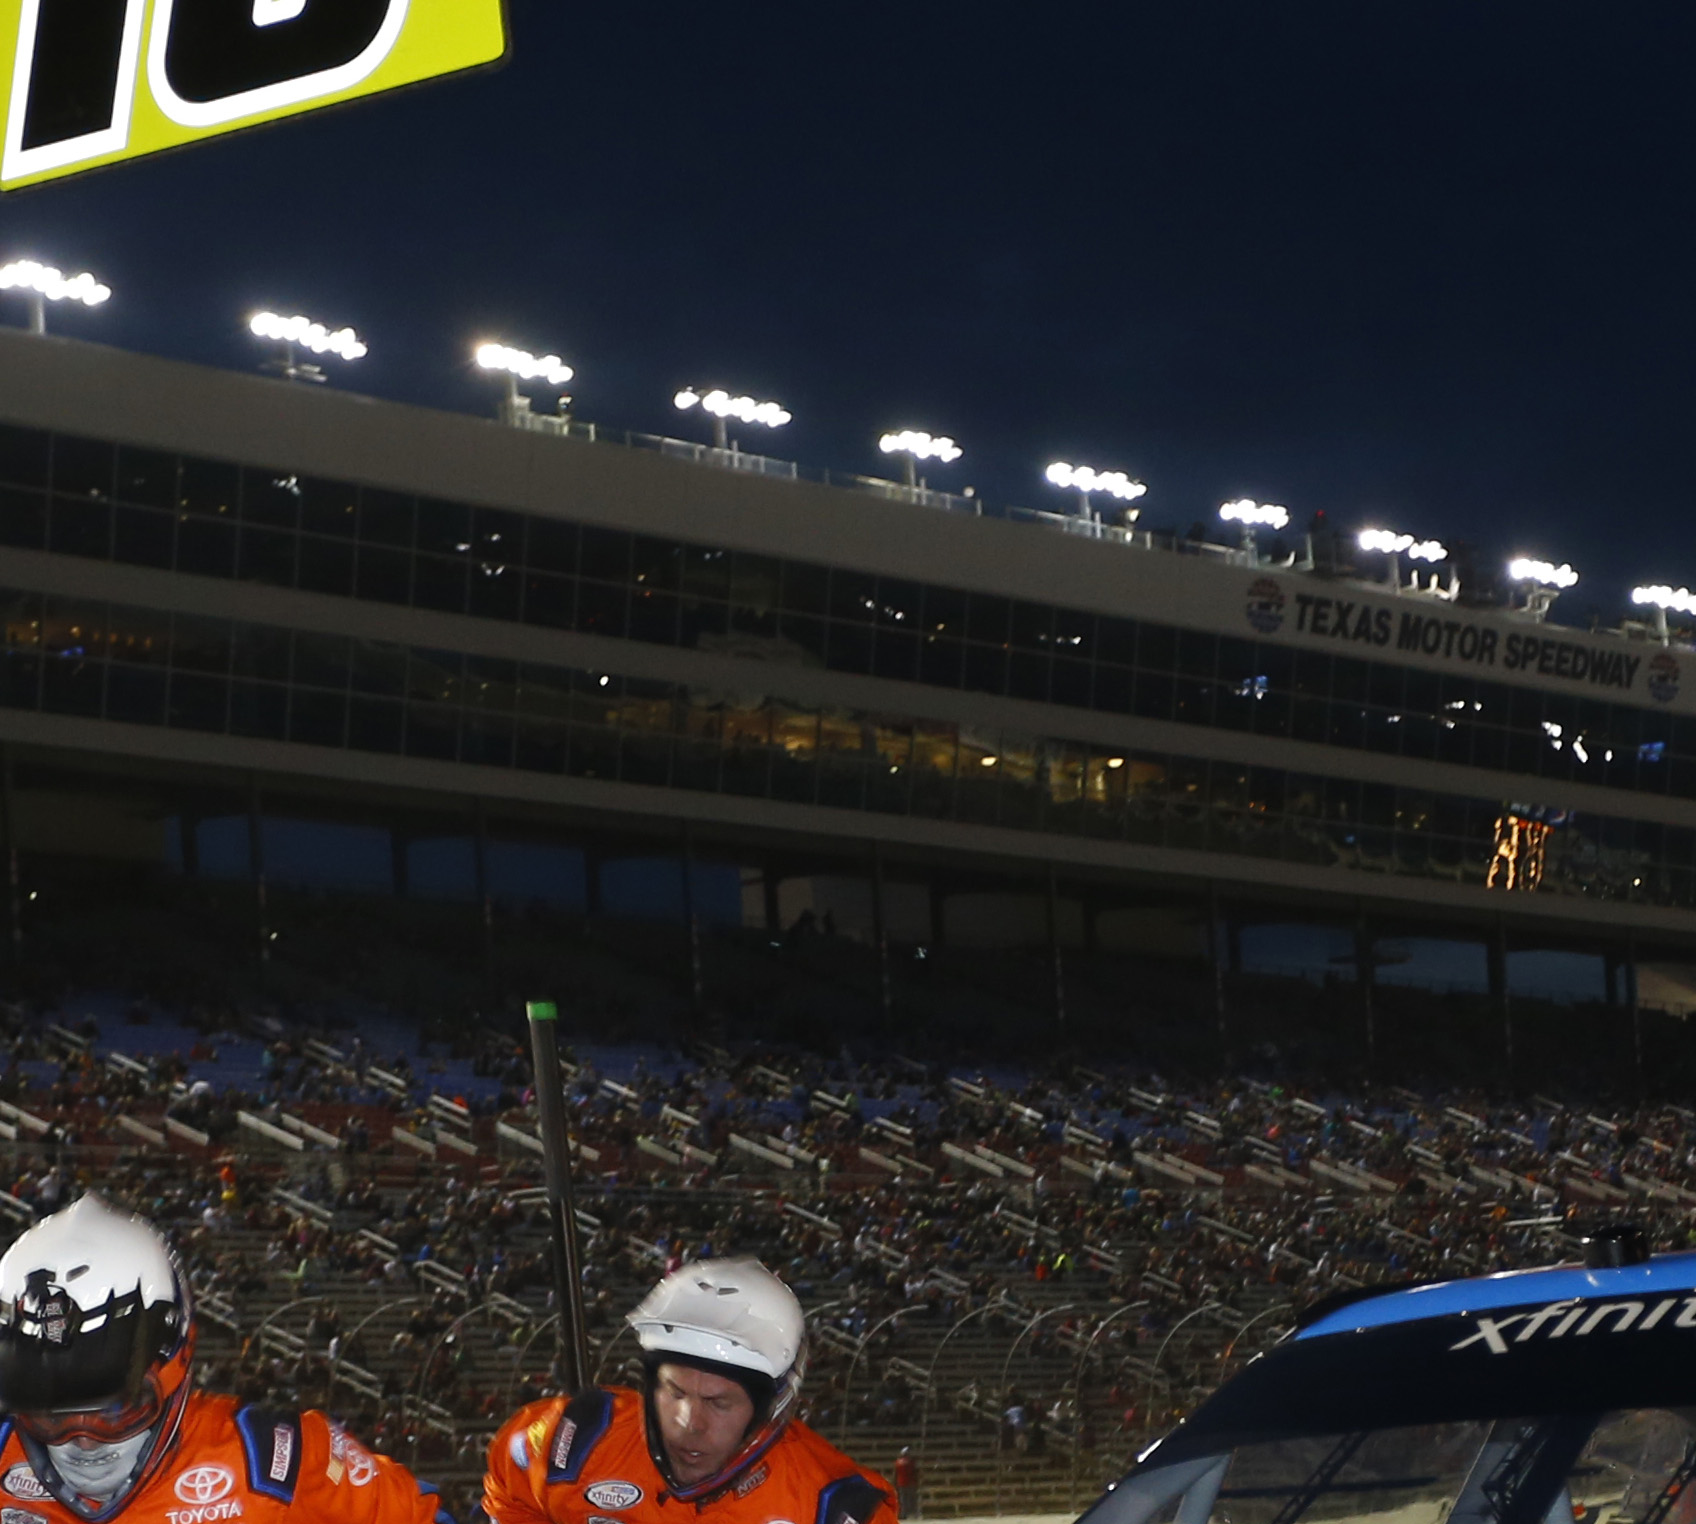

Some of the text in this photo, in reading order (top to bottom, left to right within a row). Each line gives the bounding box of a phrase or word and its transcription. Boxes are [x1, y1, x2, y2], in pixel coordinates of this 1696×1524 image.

[1295, 594, 1641, 691] TEXAS MOTOR SPEEDWAY
